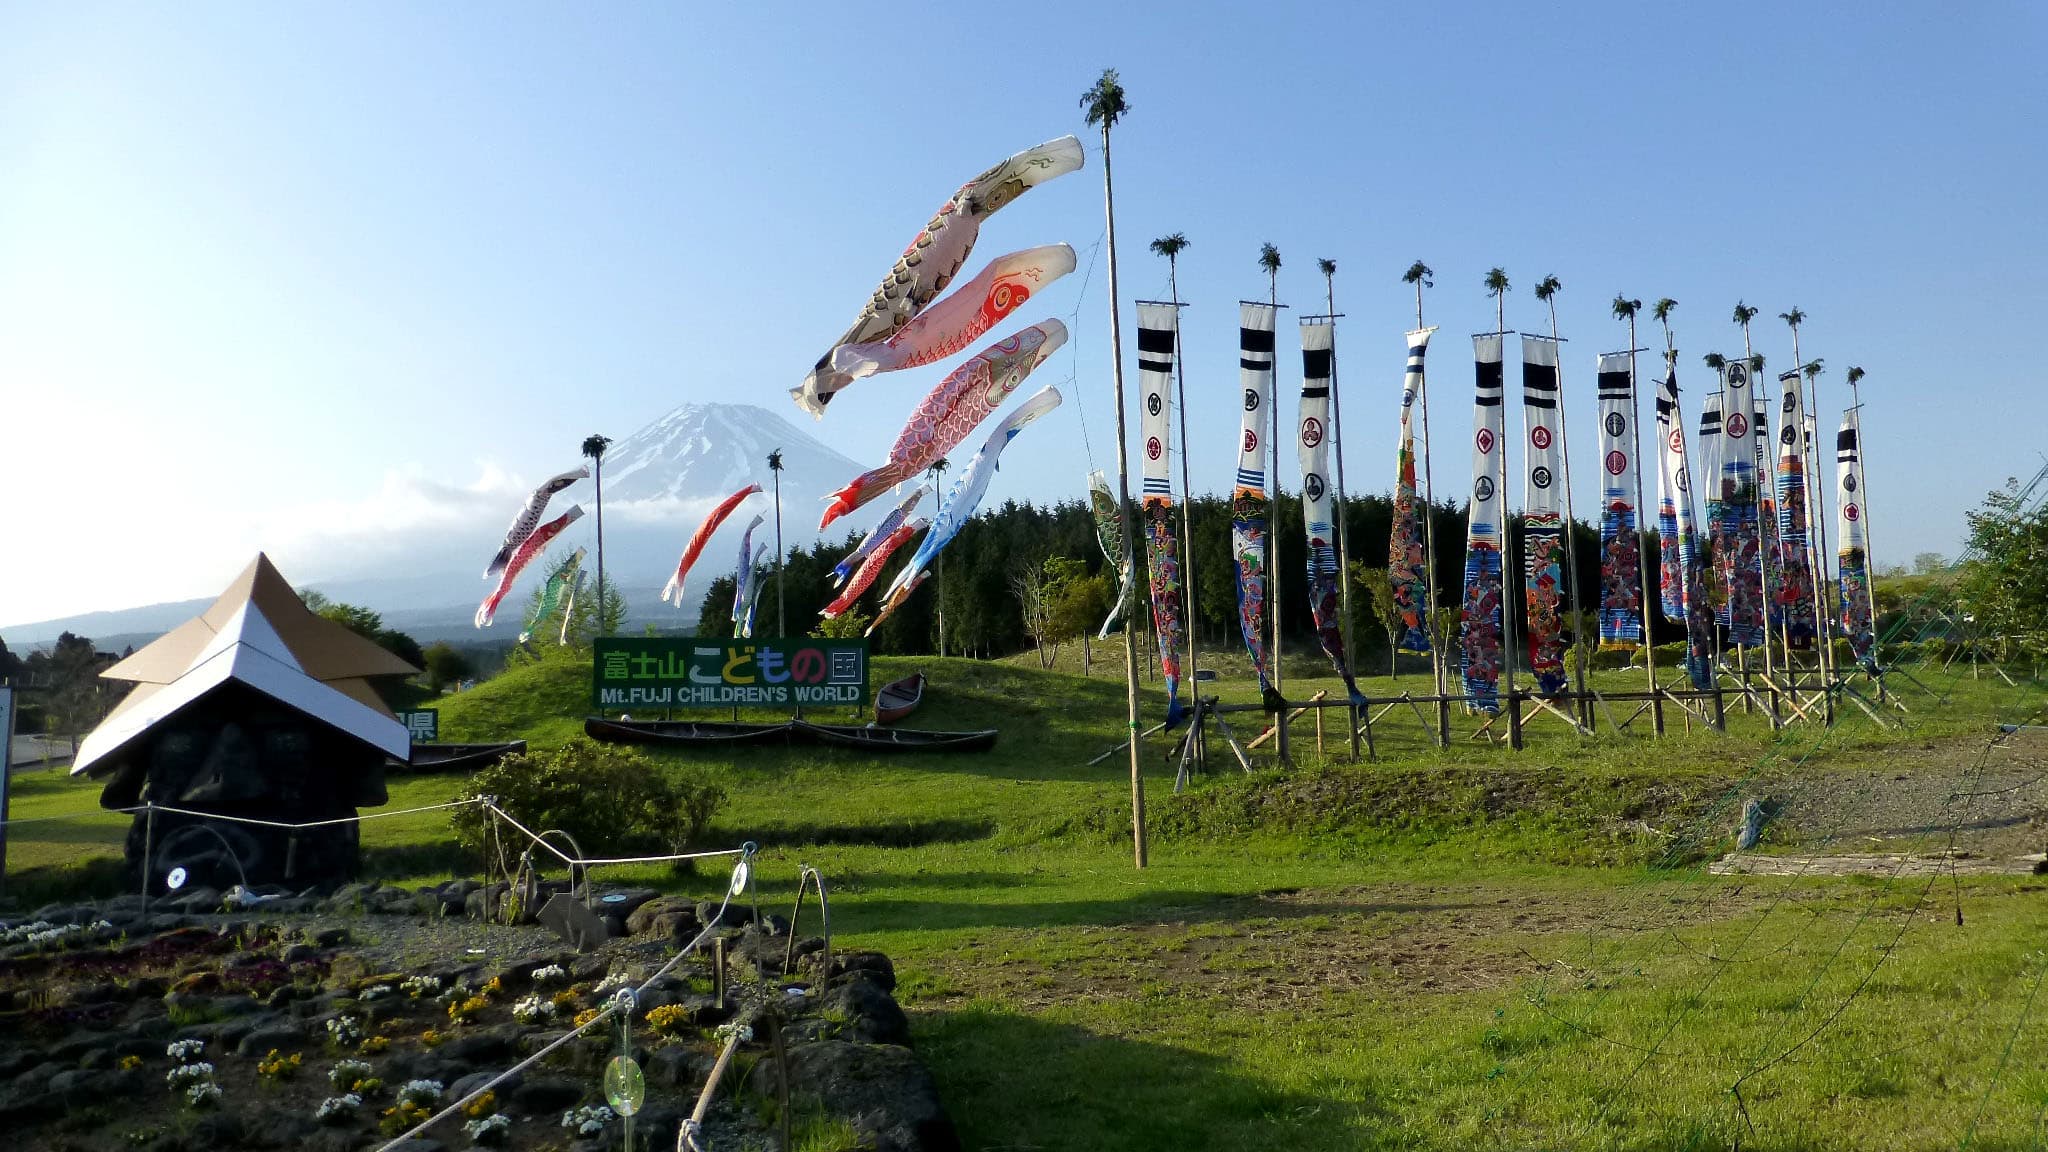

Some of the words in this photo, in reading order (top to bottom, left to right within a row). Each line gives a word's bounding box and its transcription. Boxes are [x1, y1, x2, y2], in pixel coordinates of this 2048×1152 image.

[678, 687, 788, 703] CHILDREN'S
[795, 686, 860, 701] WORLD
[397, 712, 435, 740] 県
